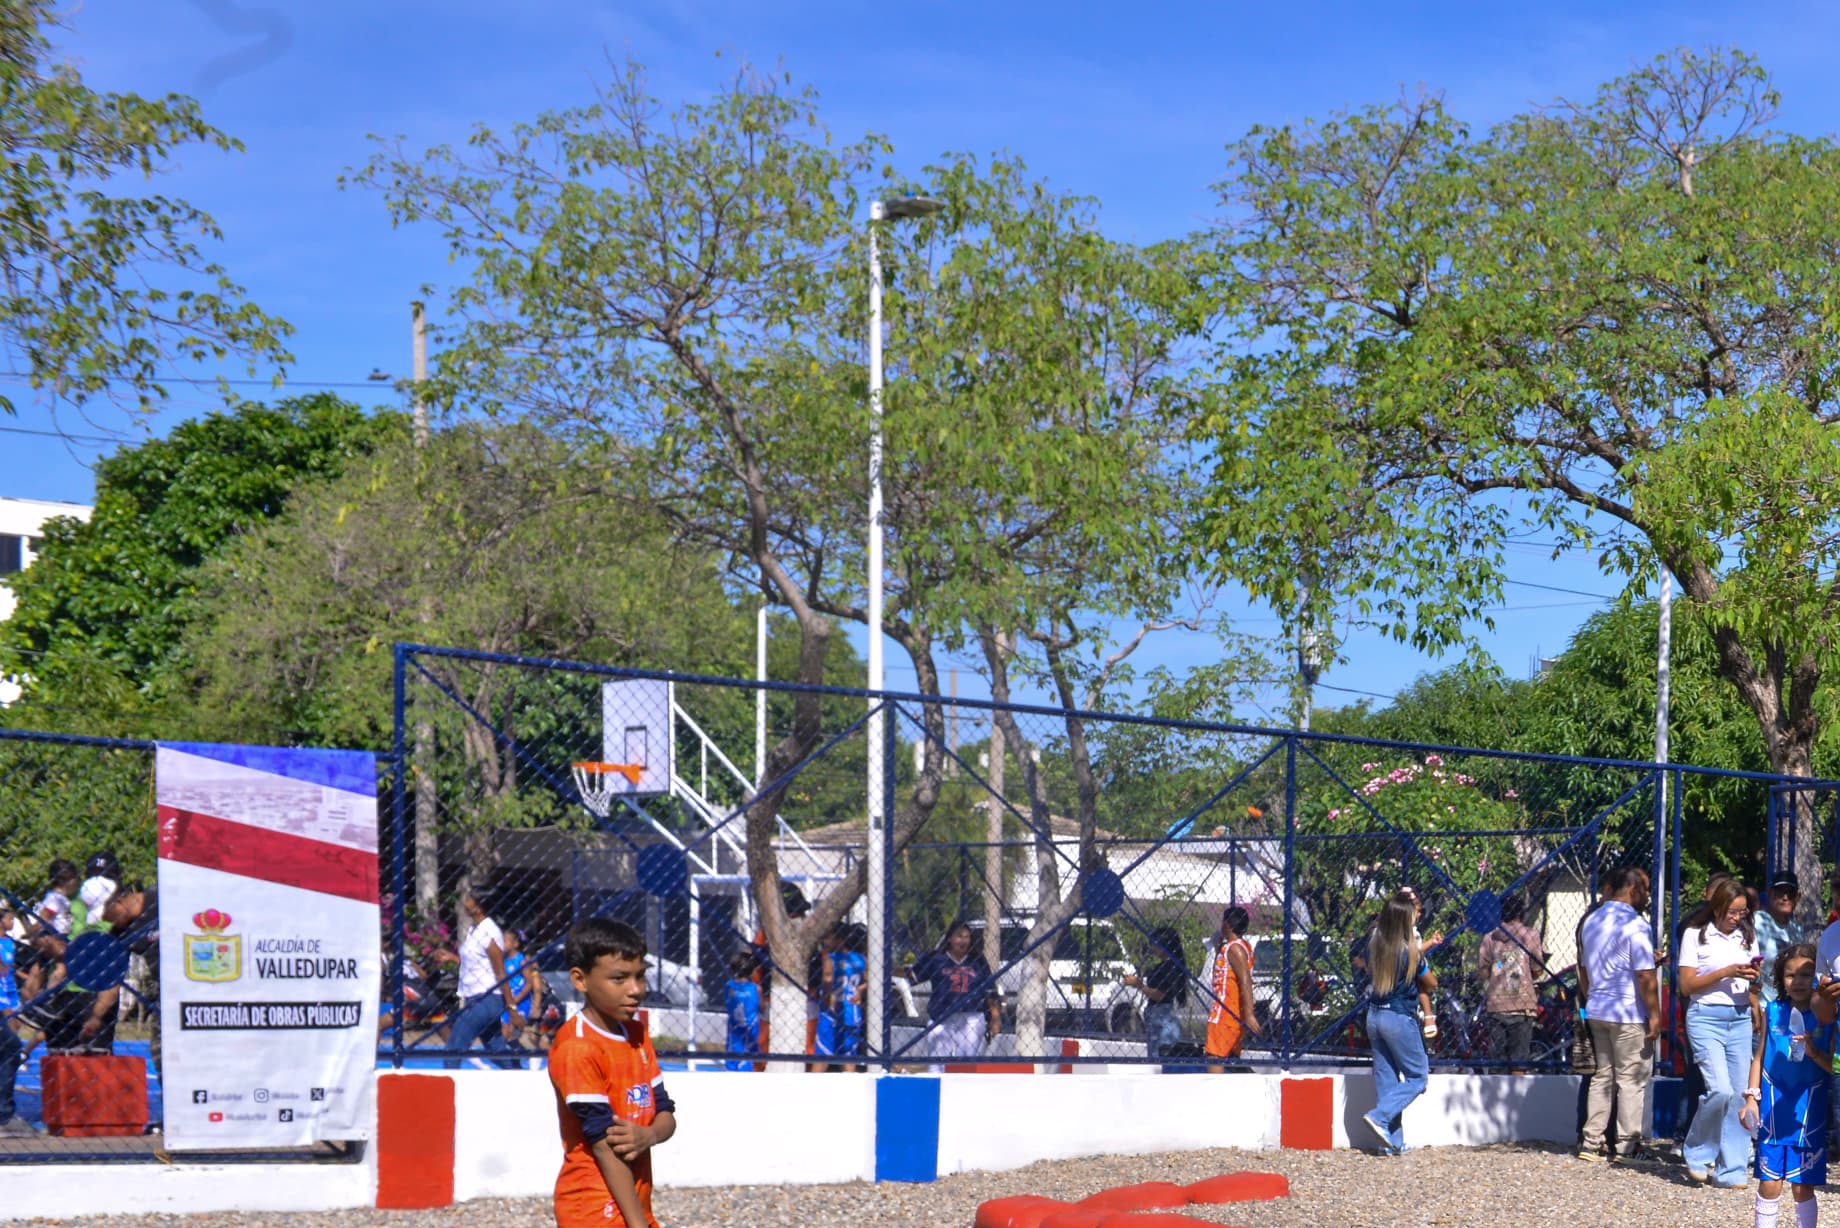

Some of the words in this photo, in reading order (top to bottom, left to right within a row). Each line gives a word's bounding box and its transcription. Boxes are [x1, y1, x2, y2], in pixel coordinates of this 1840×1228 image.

[254, 936, 304, 954] ALCALDÍA
[307, 939, 321, 954] DE
[255, 958, 359, 979] VALLEDUPAR
[184, 1003, 250, 1026] SECRETARÍA
[251, 1006, 267, 1026] DE
[268, 1005, 306, 1026] OBRAS
[307, 1002, 358, 1026] PÚBLICAS
